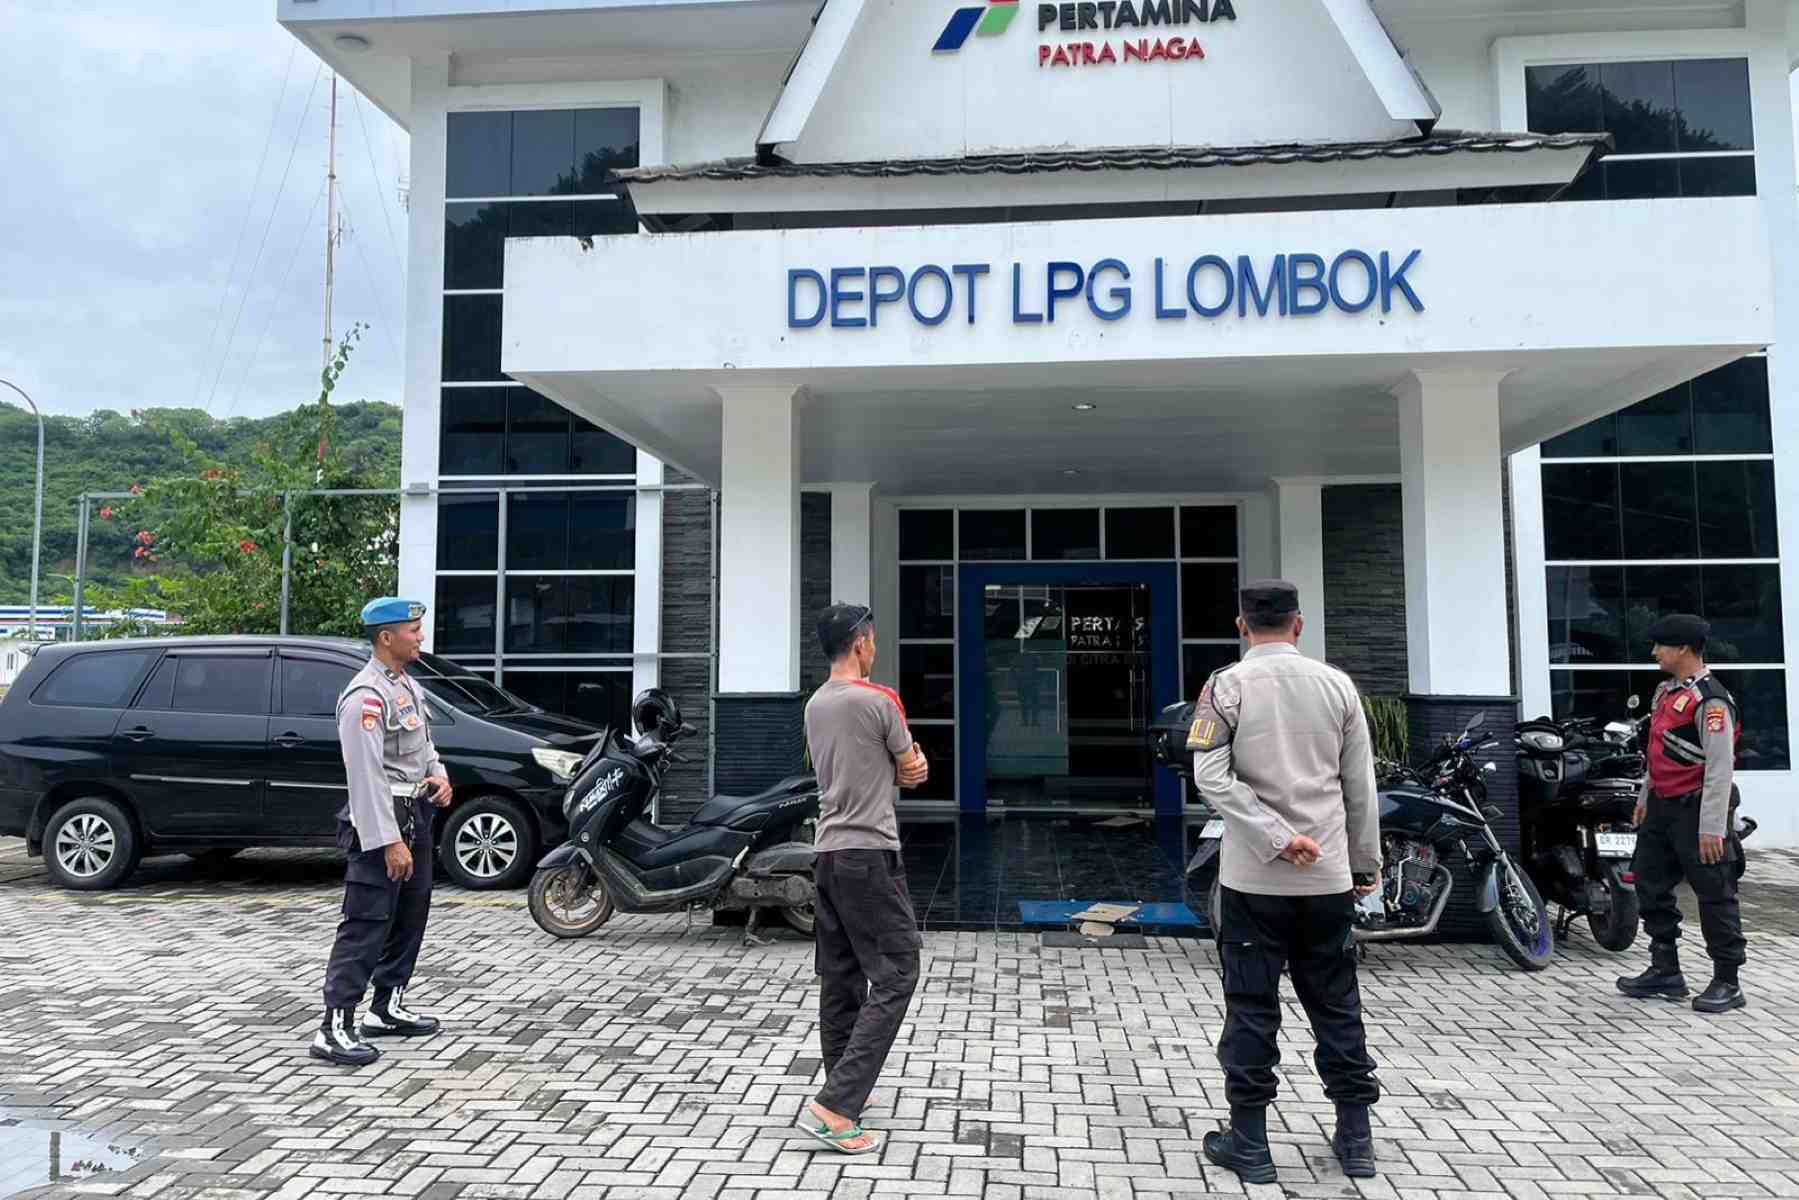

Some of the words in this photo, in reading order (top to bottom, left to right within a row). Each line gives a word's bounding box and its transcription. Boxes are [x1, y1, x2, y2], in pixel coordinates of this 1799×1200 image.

[1038, 0, 1237, 31] PERTAMINA
[1039, 41, 1116, 67] PATRA
[1124, 37, 1205, 63] NIAGA
[788, 264, 990, 328] DEPOT
[1012, 258, 1131, 323] LPG
[1155, 249, 1425, 319] LOMBOK
